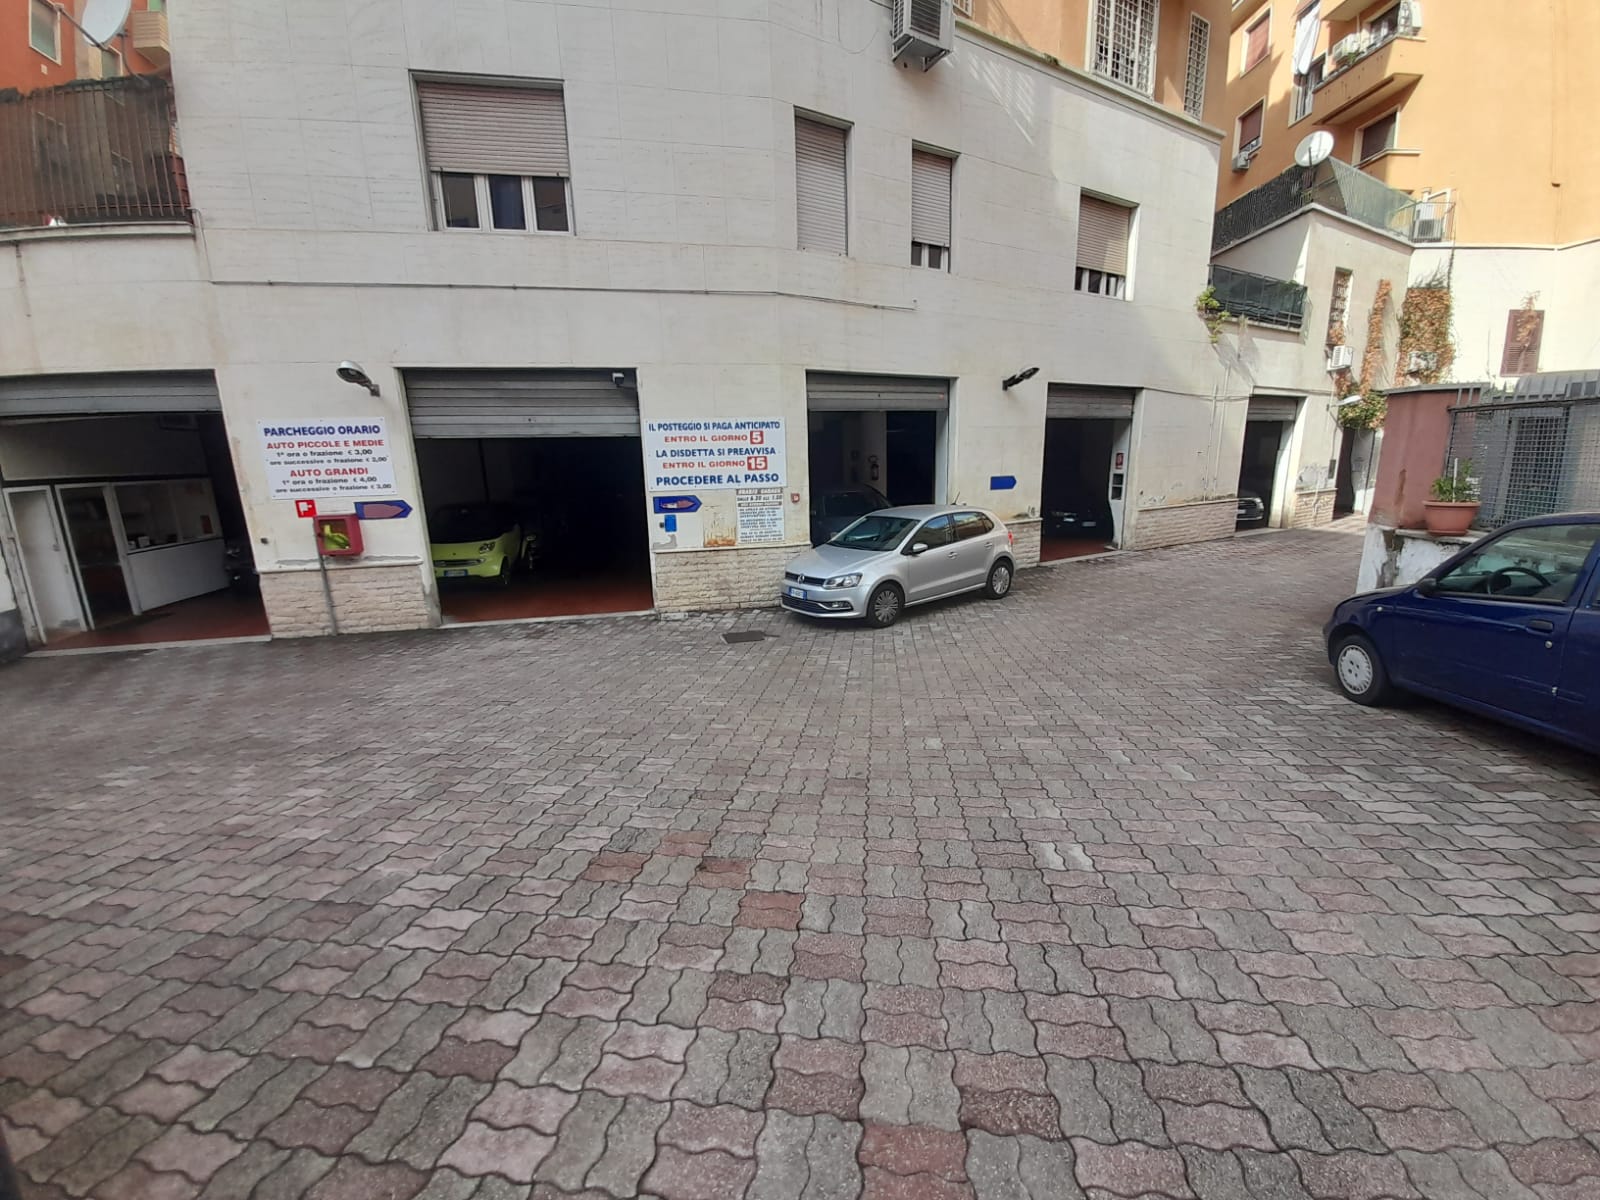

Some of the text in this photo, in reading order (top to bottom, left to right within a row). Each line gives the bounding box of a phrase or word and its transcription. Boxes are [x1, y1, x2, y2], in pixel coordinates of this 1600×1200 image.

[264, 425, 380, 436] PARCHEGGIO ORARIO
[649, 423, 656, 431] IL
[658, 423, 702, 431] POSTEGGIO
[735, 421, 780, 430] ANTICIPATO
[751, 431, 762, 443] 5
[656, 449, 668, 458] LA
[670, 449, 715, 457] DISDETTA
[728, 447, 776, 456] PREAVVISA
[748, 457, 766, 470] 15
[290, 469, 321, 477] AUTO
[656, 473, 779, 486] PROCEDERE AL PASSO
